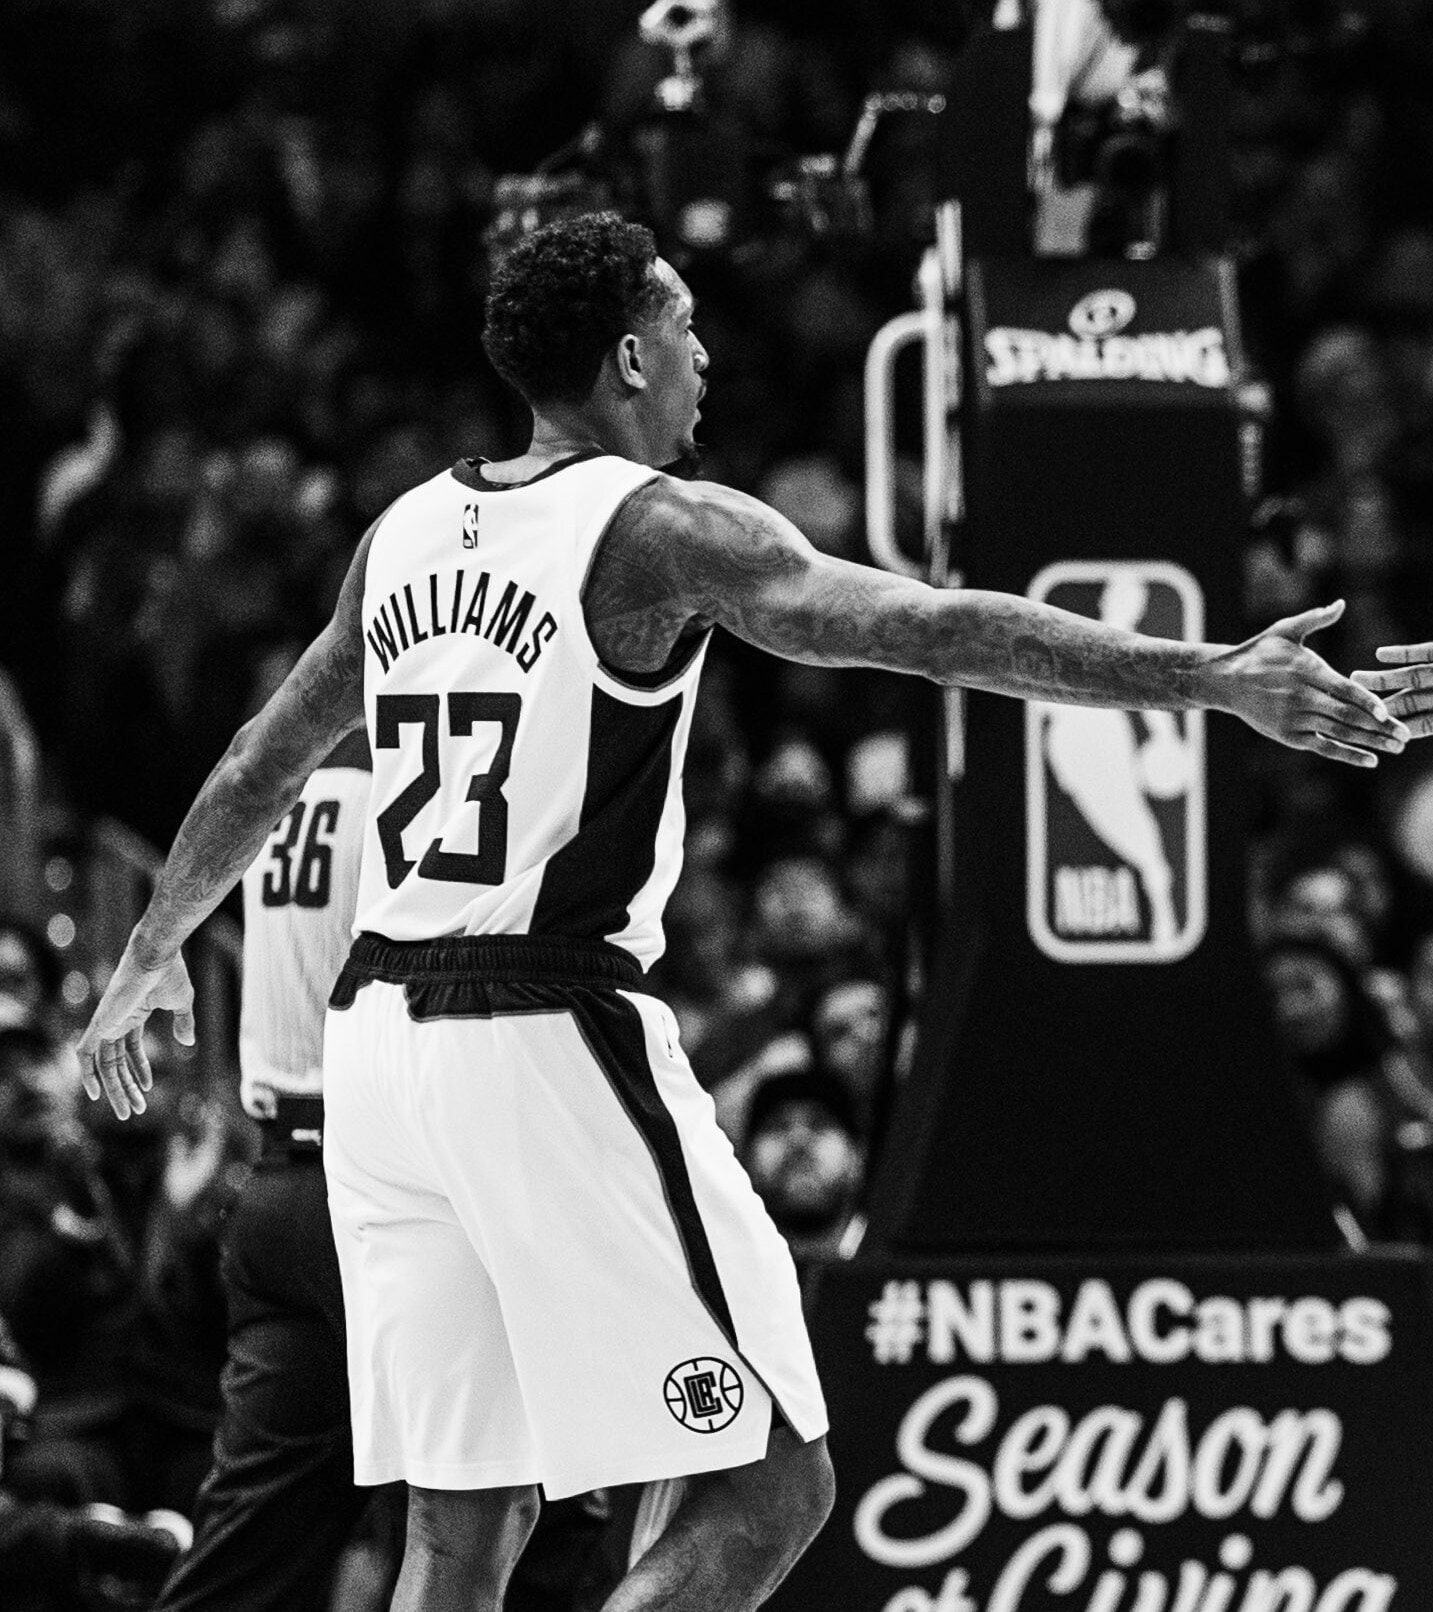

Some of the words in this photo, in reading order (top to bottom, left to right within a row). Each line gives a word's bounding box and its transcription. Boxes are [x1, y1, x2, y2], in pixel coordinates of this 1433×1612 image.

[985, 326, 1231, 387] SPALDING
[367, 569, 557, 674] WILLIAMS
[375, 692, 522, 890] 23
[262, 801, 341, 909] 36
[866, 1279, 1392, 1364] #NBACares
[854, 1375, 1344, 1568] Season
